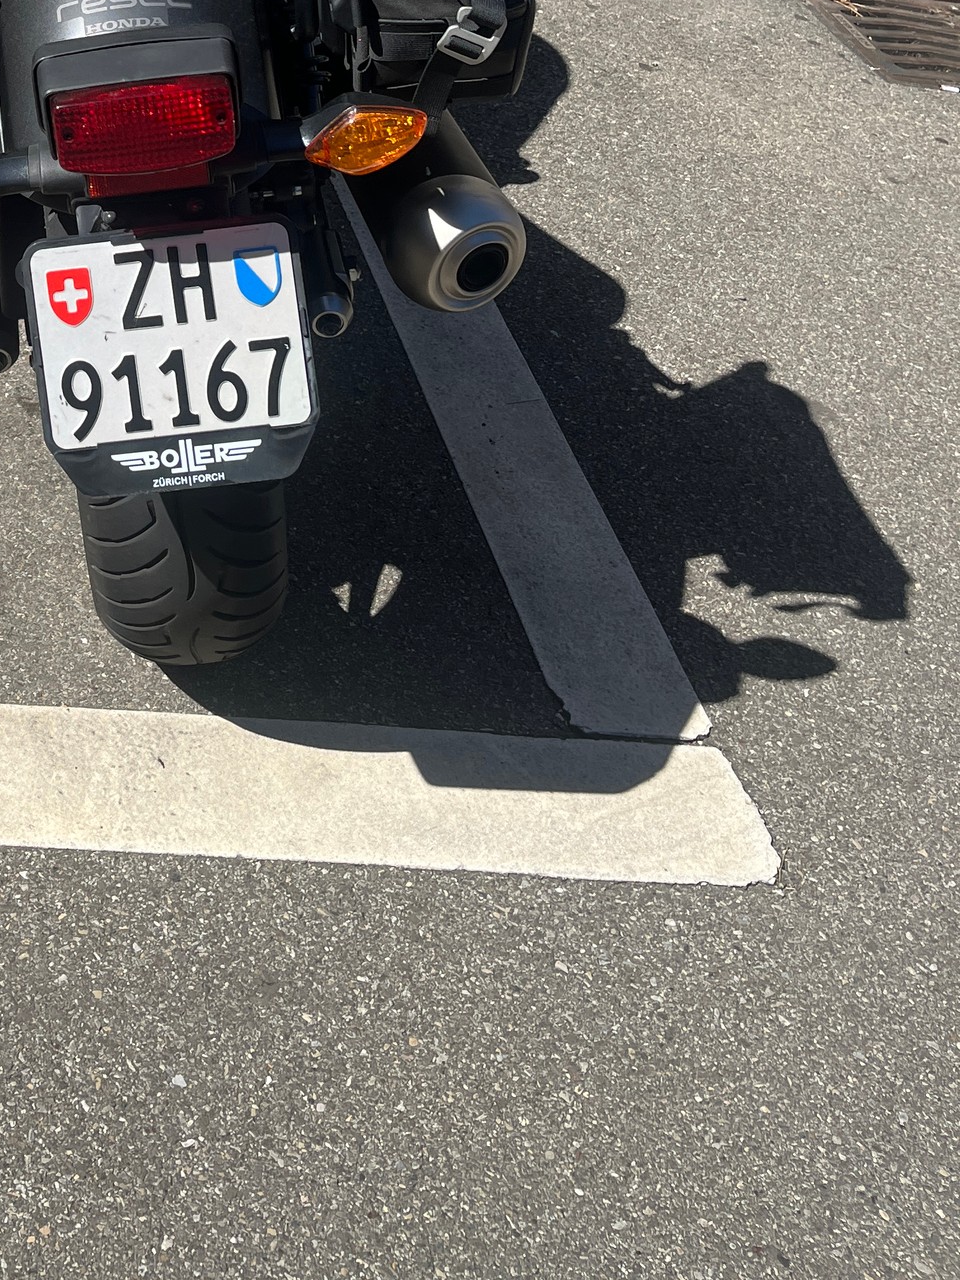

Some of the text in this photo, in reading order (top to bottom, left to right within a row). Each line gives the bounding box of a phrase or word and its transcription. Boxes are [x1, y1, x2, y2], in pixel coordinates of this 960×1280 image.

[85, 16, 167, 35] HONDA
[113, 243, 217, 330] ZH
[61, 336, 290, 442] 91167
[141, 439, 233, 474] BOLLER
